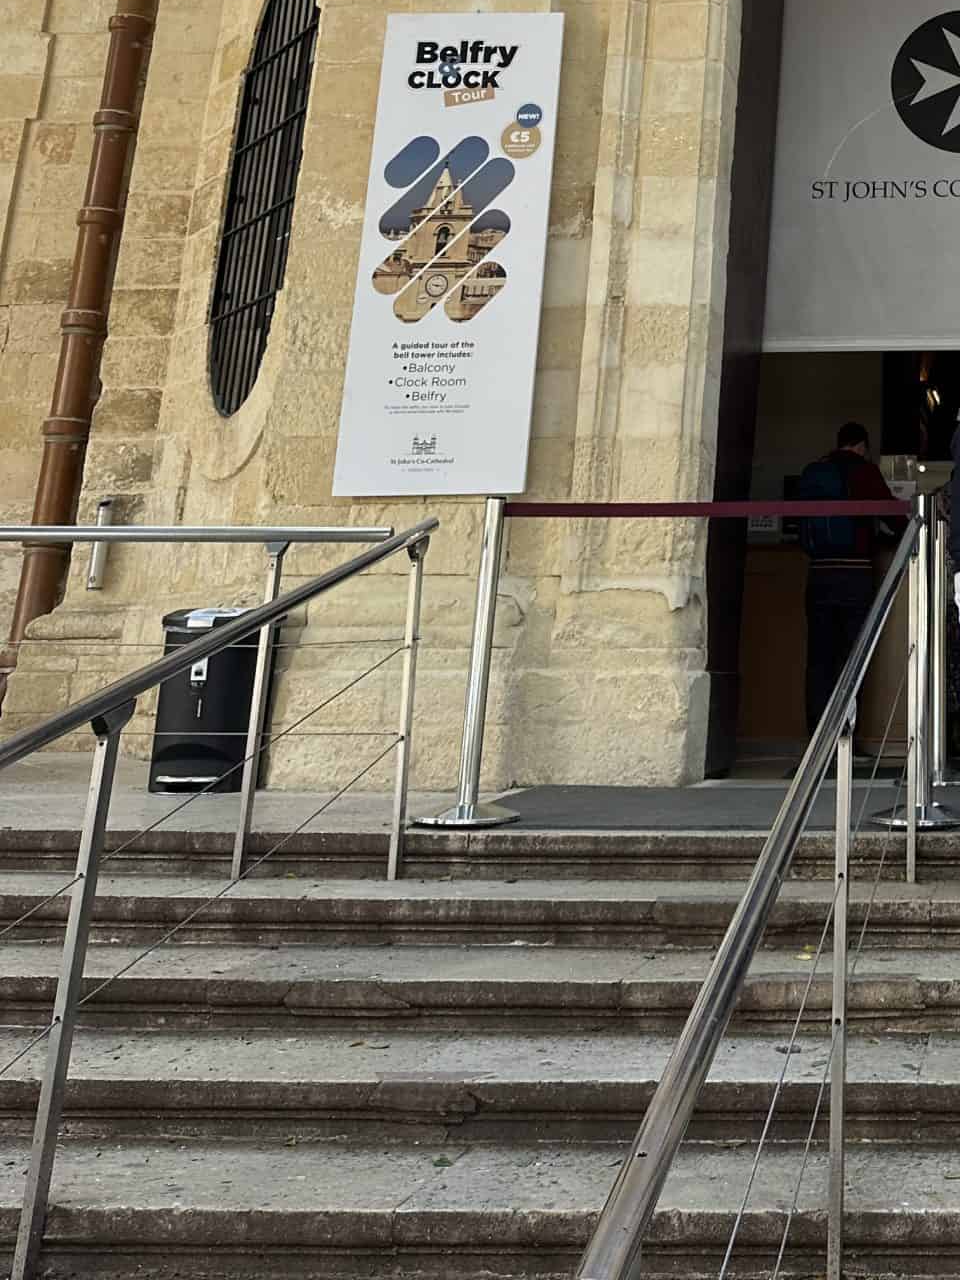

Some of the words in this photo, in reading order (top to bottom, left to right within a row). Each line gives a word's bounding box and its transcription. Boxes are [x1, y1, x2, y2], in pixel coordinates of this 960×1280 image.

[416, 41, 518, 68] Belfry
[439, 57, 461, 77] &
[408, 70, 501, 89] CLOCK
[451, 90, 487, 103] Tour
[510, 131, 530, 142] €5
[812, 181, 838, 200] ST
[843, 180, 927, 202] JOHN'S
[401, 342, 429, 350] guided
[450, 341, 460, 349] of
[461, 341, 474, 349] the
[408, 362, 455, 374] Balcony
[395, 376, 428, 387] Clock
[432, 376, 466, 386] Room
[412, 390, 447, 402] Belfry
